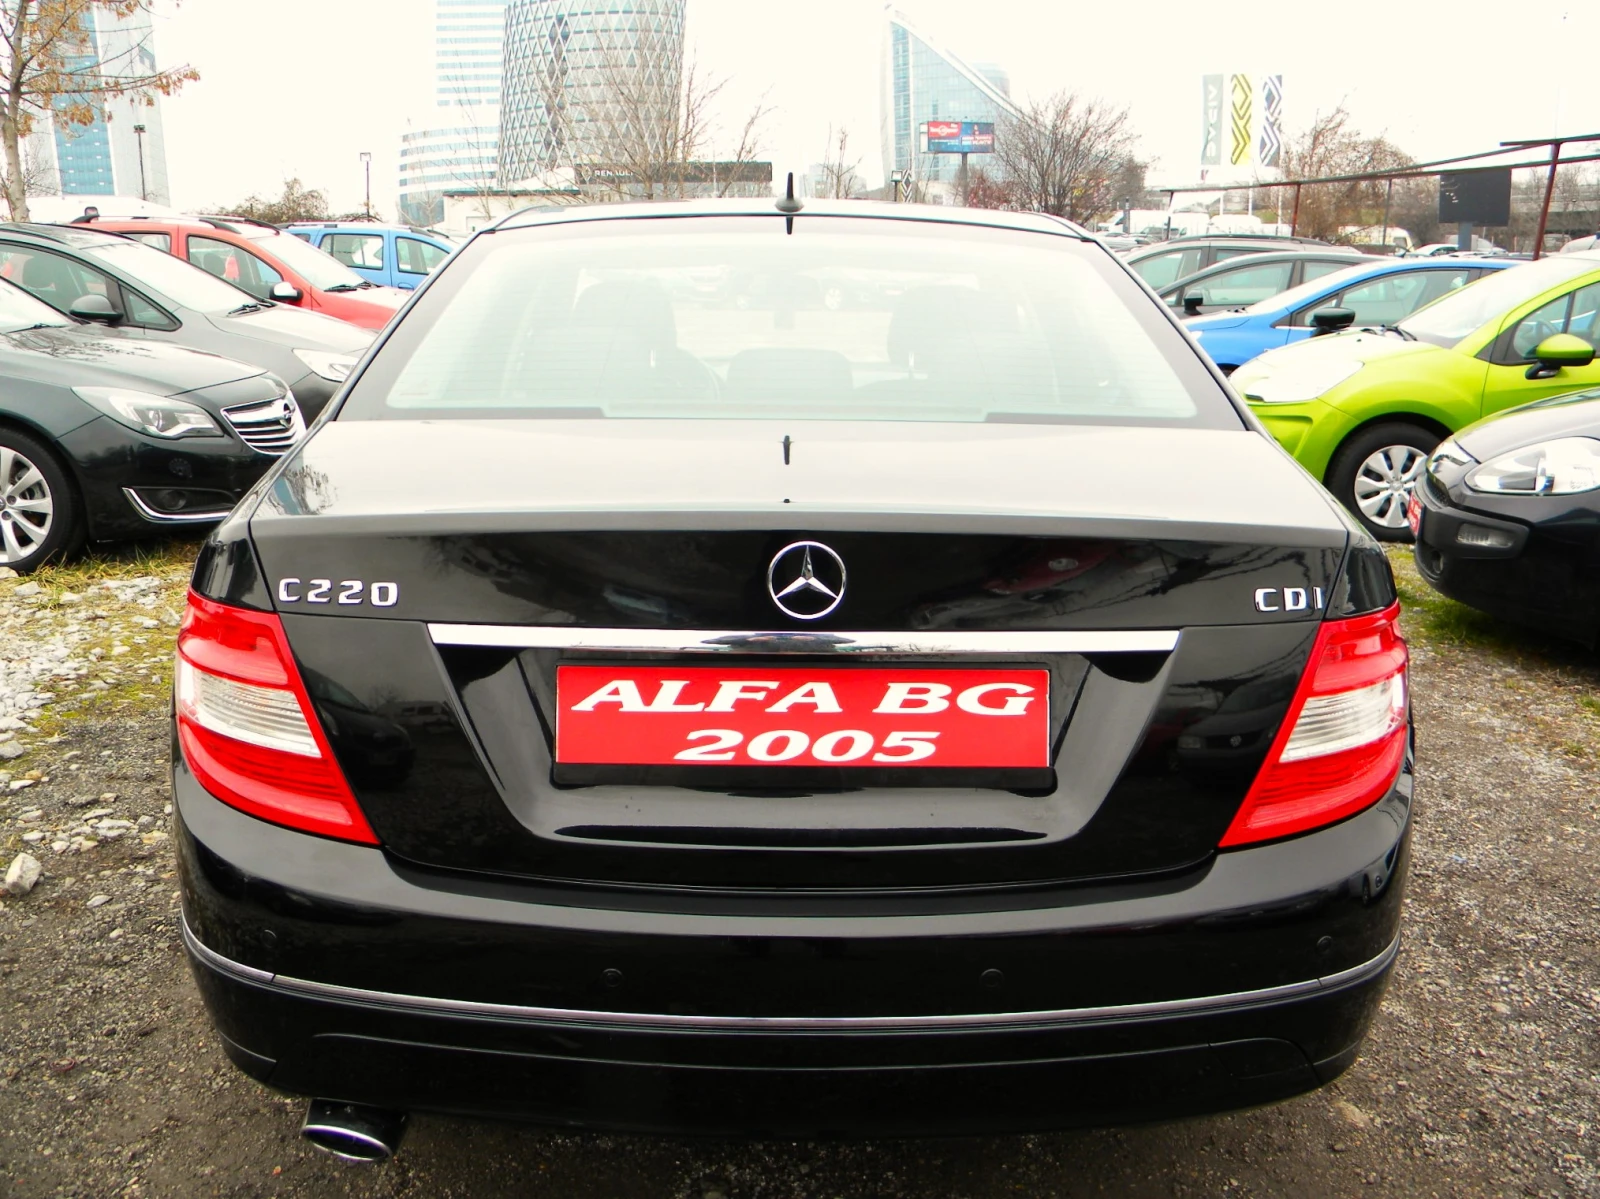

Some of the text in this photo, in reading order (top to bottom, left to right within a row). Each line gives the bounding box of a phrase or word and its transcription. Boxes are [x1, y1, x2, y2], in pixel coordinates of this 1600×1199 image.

[279, 578, 397, 605] C220
[1255, 587, 1322, 611] CDI
[571, 680, 1034, 715] ALFA BG
[674, 729, 940, 762] 2005
